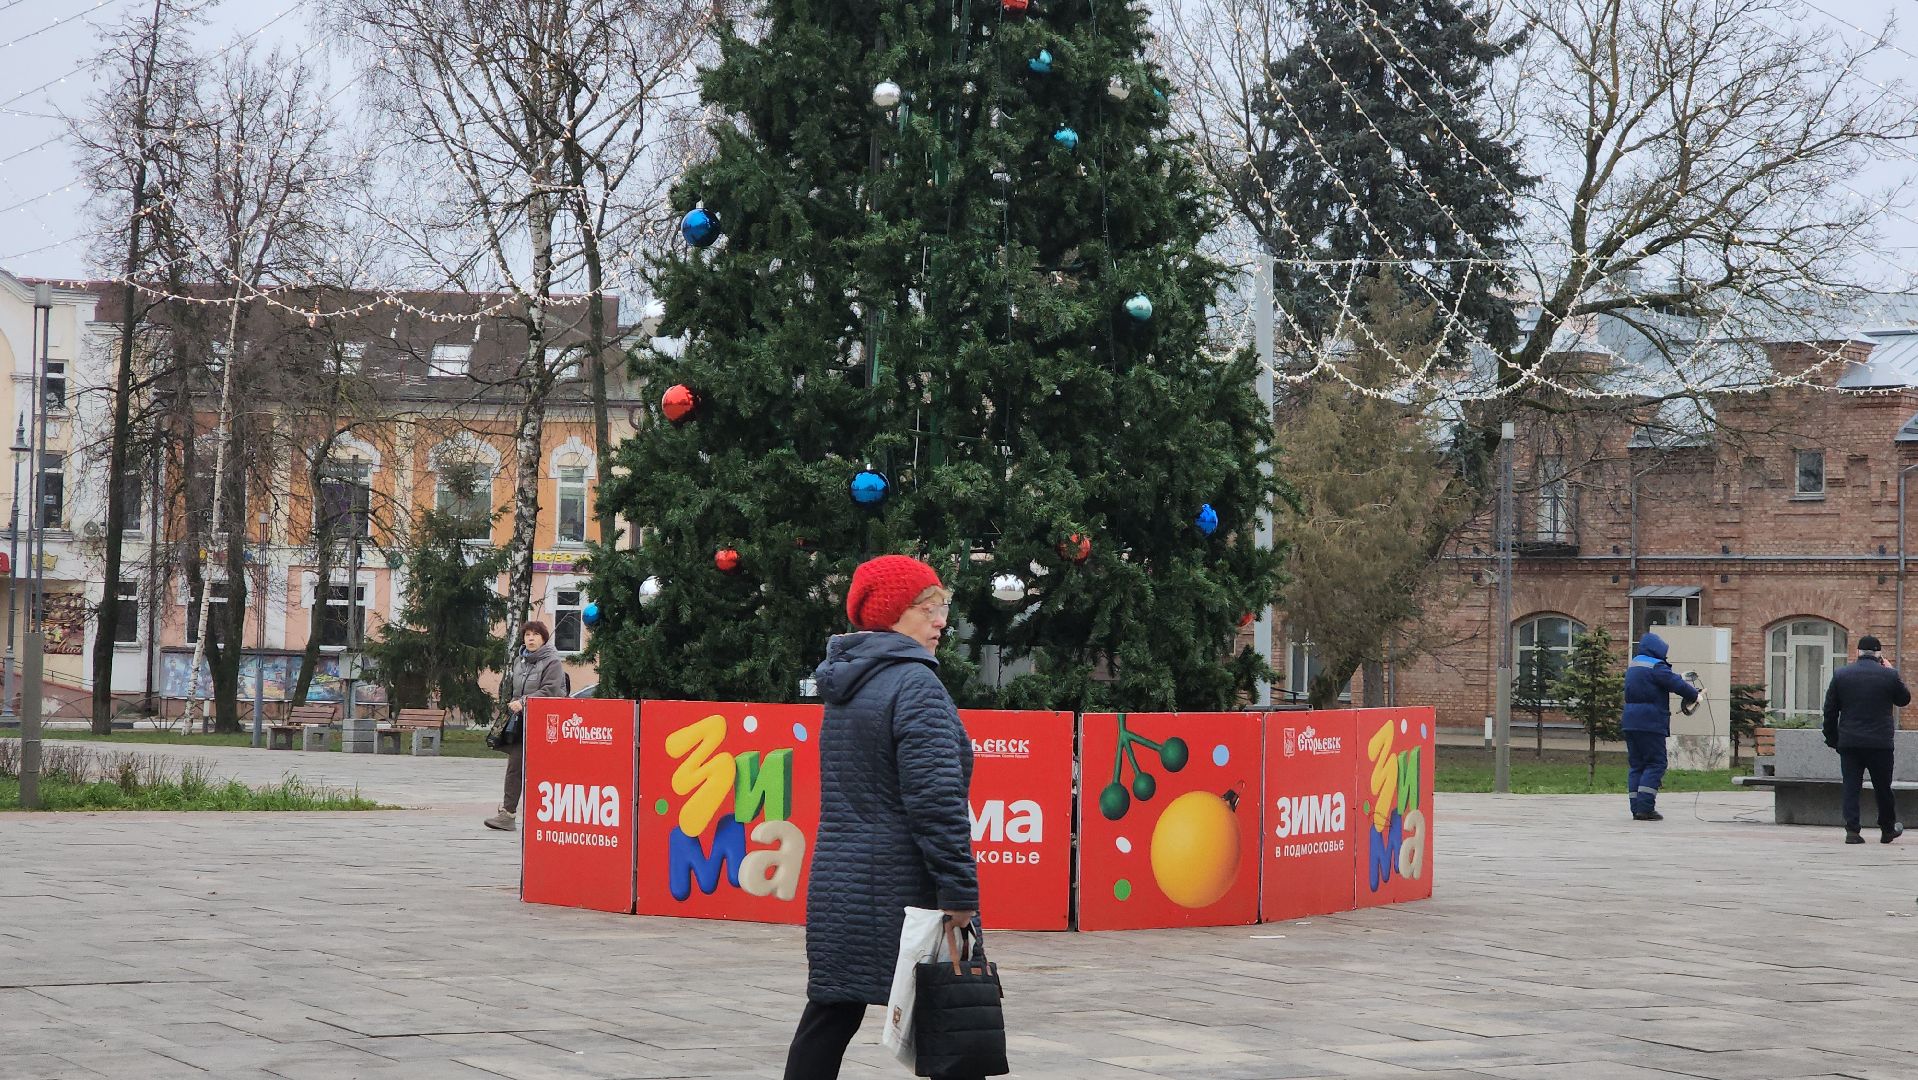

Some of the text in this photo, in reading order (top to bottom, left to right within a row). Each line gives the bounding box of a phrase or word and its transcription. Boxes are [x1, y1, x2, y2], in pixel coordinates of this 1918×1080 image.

[971, 739, 1030, 753] ьевск
[968, 799, 1043, 844] ма
[536, 829, 618, 848] в подмосковье
[1275, 839, 1344, 858] в подмосковье
